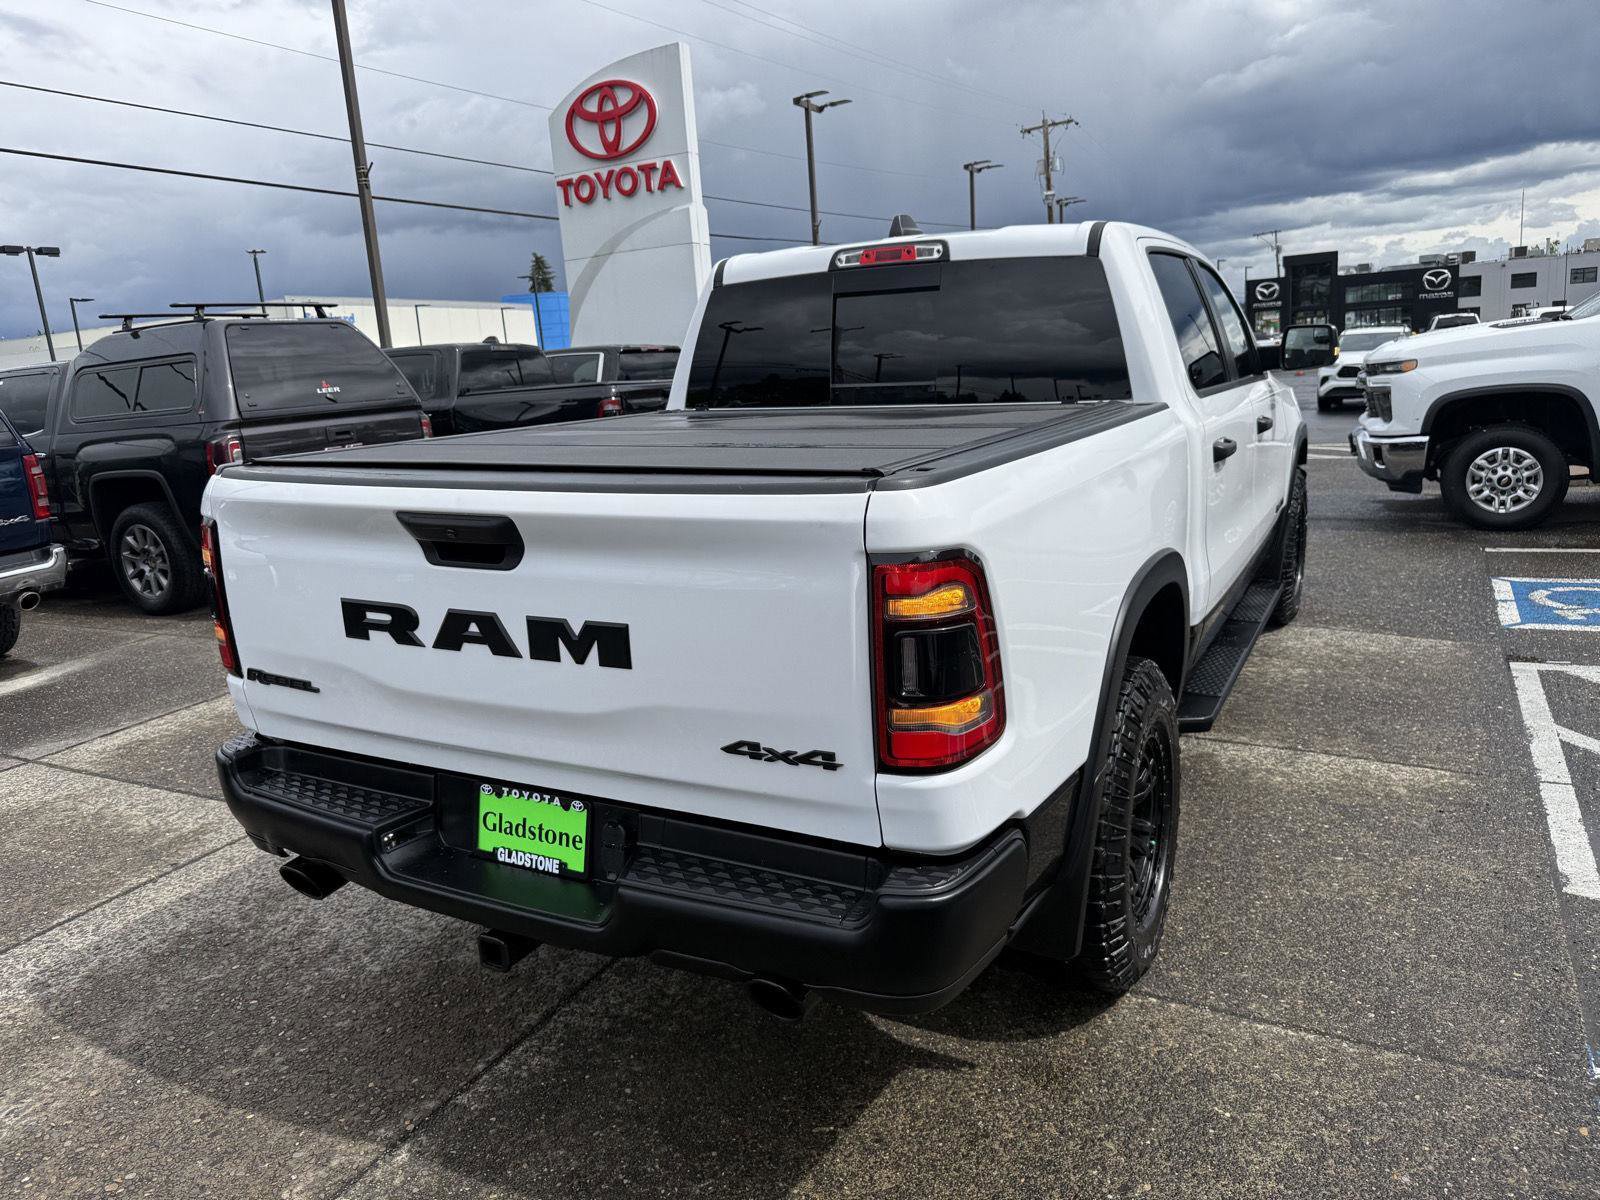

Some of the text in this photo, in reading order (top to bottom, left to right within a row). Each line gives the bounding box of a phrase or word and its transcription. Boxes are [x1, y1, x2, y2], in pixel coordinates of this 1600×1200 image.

[556, 160, 684, 207] TOYOTA
[316, 386, 341, 394] LEER
[340, 597, 632, 669] RAM
[502, 787, 561, 806] TOYOTA
[482, 811, 583, 850] Gladstone
[497, 847, 560, 874] GLADSTONE
